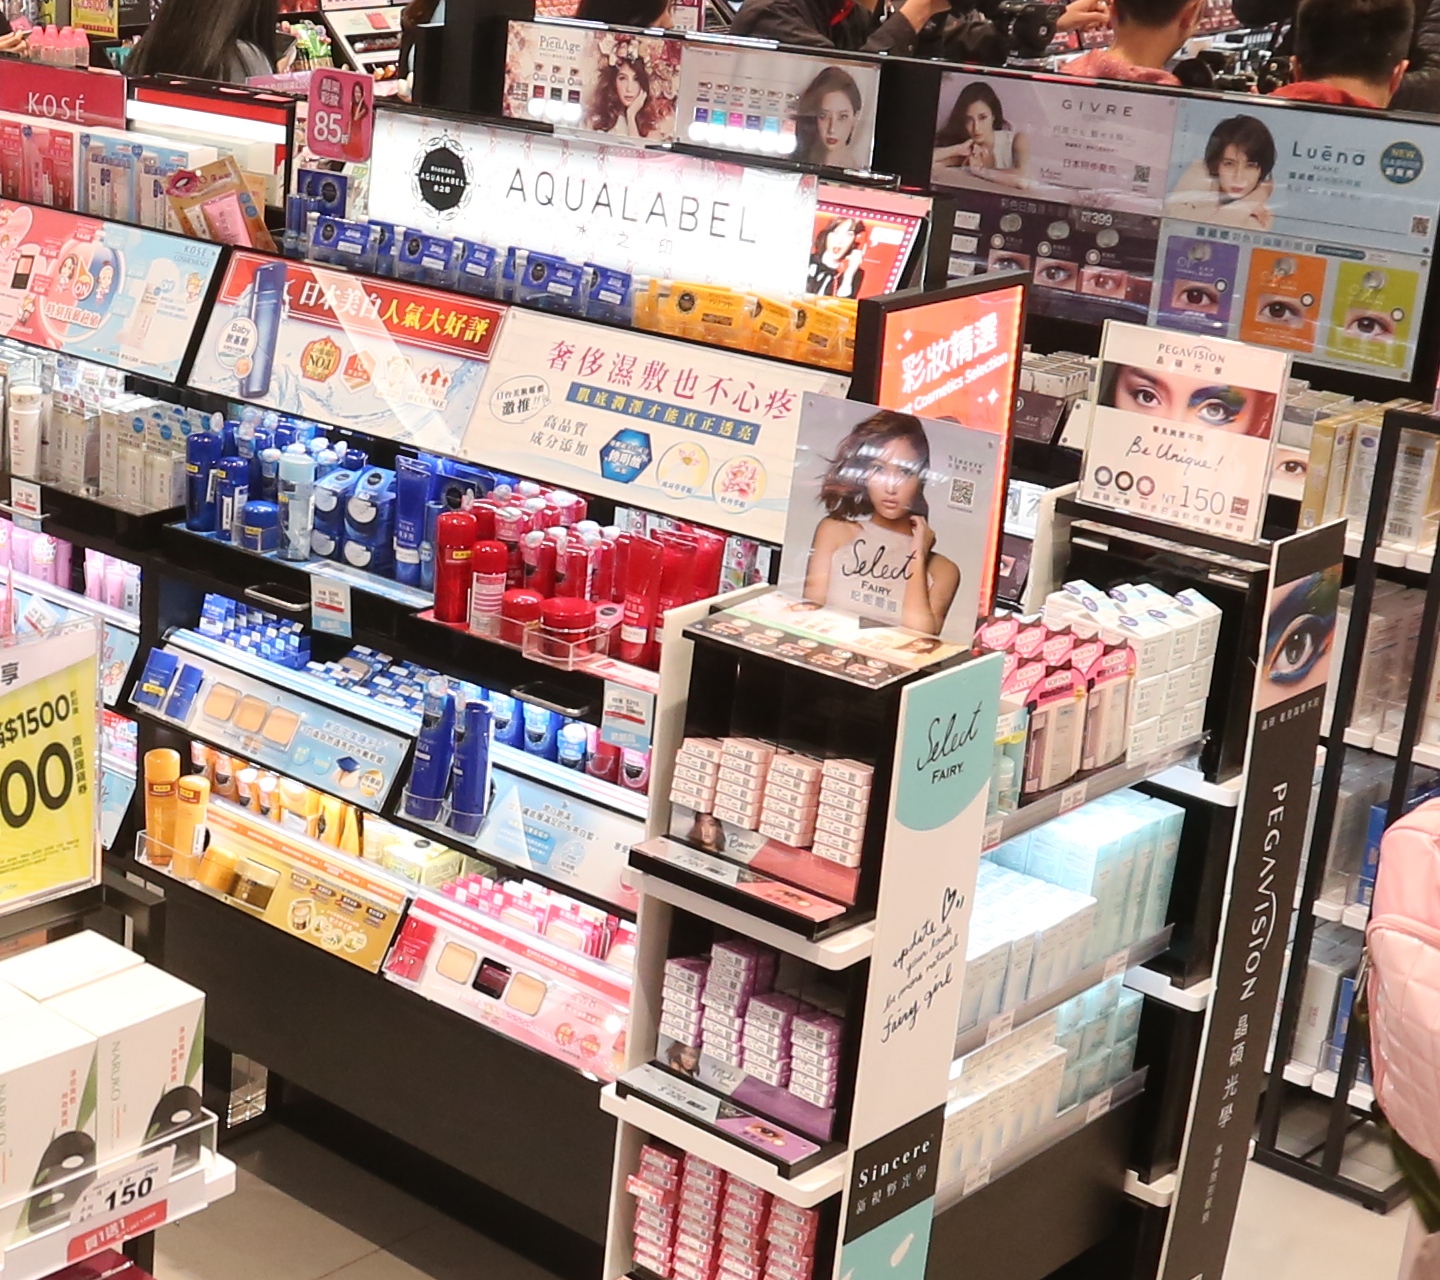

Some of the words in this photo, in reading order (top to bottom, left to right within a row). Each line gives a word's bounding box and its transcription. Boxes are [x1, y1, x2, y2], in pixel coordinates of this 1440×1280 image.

[28, 91, 85, 120] KOSÉ
[1061, 98, 1135, 118] GIVRE
[420, 172, 464, 189] AQUALABEL
[506, 168, 757, 245] AQUALABEL
[230, 322, 252, 337] Baby
[298, 280, 491, 345] 日本美白人氣大好評
[901, 312, 998, 395] 彩妝精選
[1158, 342, 1225, 364] PEGAVISION
[546, 338, 799, 421] 奢侈濕敷也不心疼
[914, 376, 964, 415] Cosmetics
[964, 352, 1008, 388] Selection
[575, 387, 753, 441] 肌底潤澤才能真正透亮
[1124, 435, 1153, 459] Be
[1179, 484, 1226, 516] 150
[842, 537, 917, 583] Select
[861, 581, 892, 597] FAIRY
[916, 700, 983, 772] Select
[931, 761, 964, 784] FAIRY
[1239, 781, 1289, 1001] PEGAVISION
[110, 1039, 123, 1103] NARUKO
[1218, 1012, 1250, 1129] 晶碩光學
[858, 1138, 932, 1188] Sincere
[104, 1176, 153, 1211] 150
[856, 1165, 928, 1215] 新視野光學
